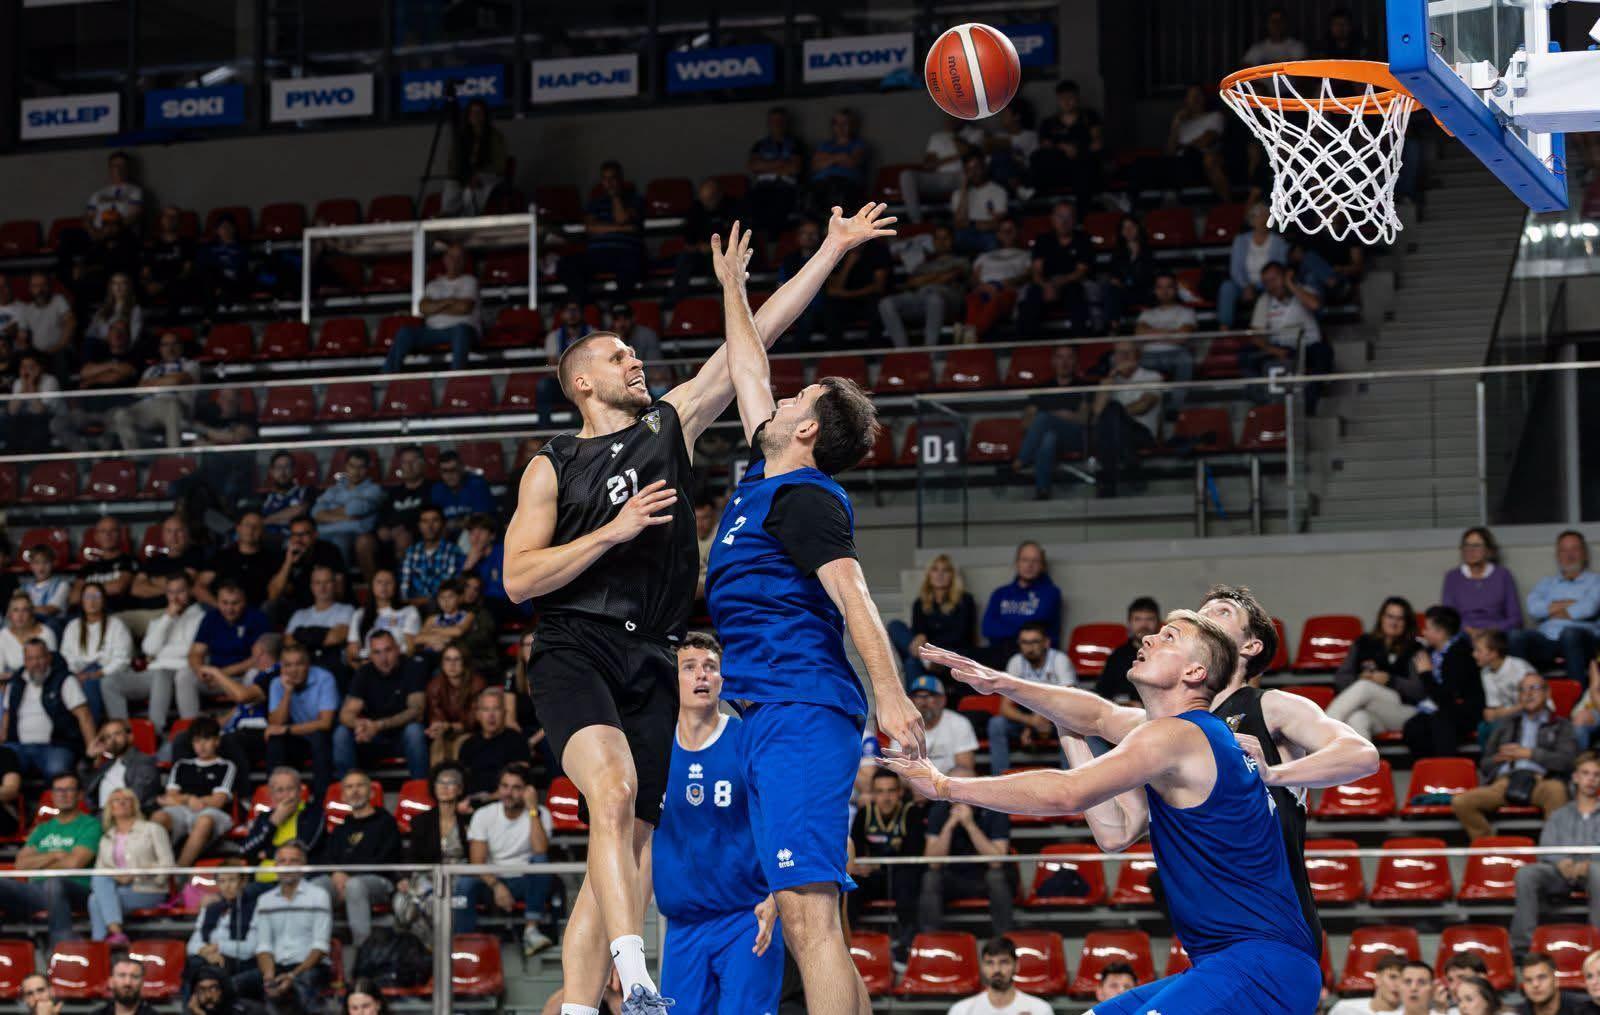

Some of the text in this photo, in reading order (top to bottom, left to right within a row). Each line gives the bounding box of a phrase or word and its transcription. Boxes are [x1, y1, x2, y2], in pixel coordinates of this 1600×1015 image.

[676, 56, 763, 80] WODA
[809, 48, 906, 68] BATONY
[538, 69, 631, 88] NAPOJE
[948, 55, 963, 97] molten
[161, 96, 224, 119] SOKI
[286, 88, 355, 108] PIWO
[28, 106, 109, 127] SKLEP
[606, 468, 638, 505] 21
[722, 516, 747, 545] 2
[714, 780, 732, 807] 8
